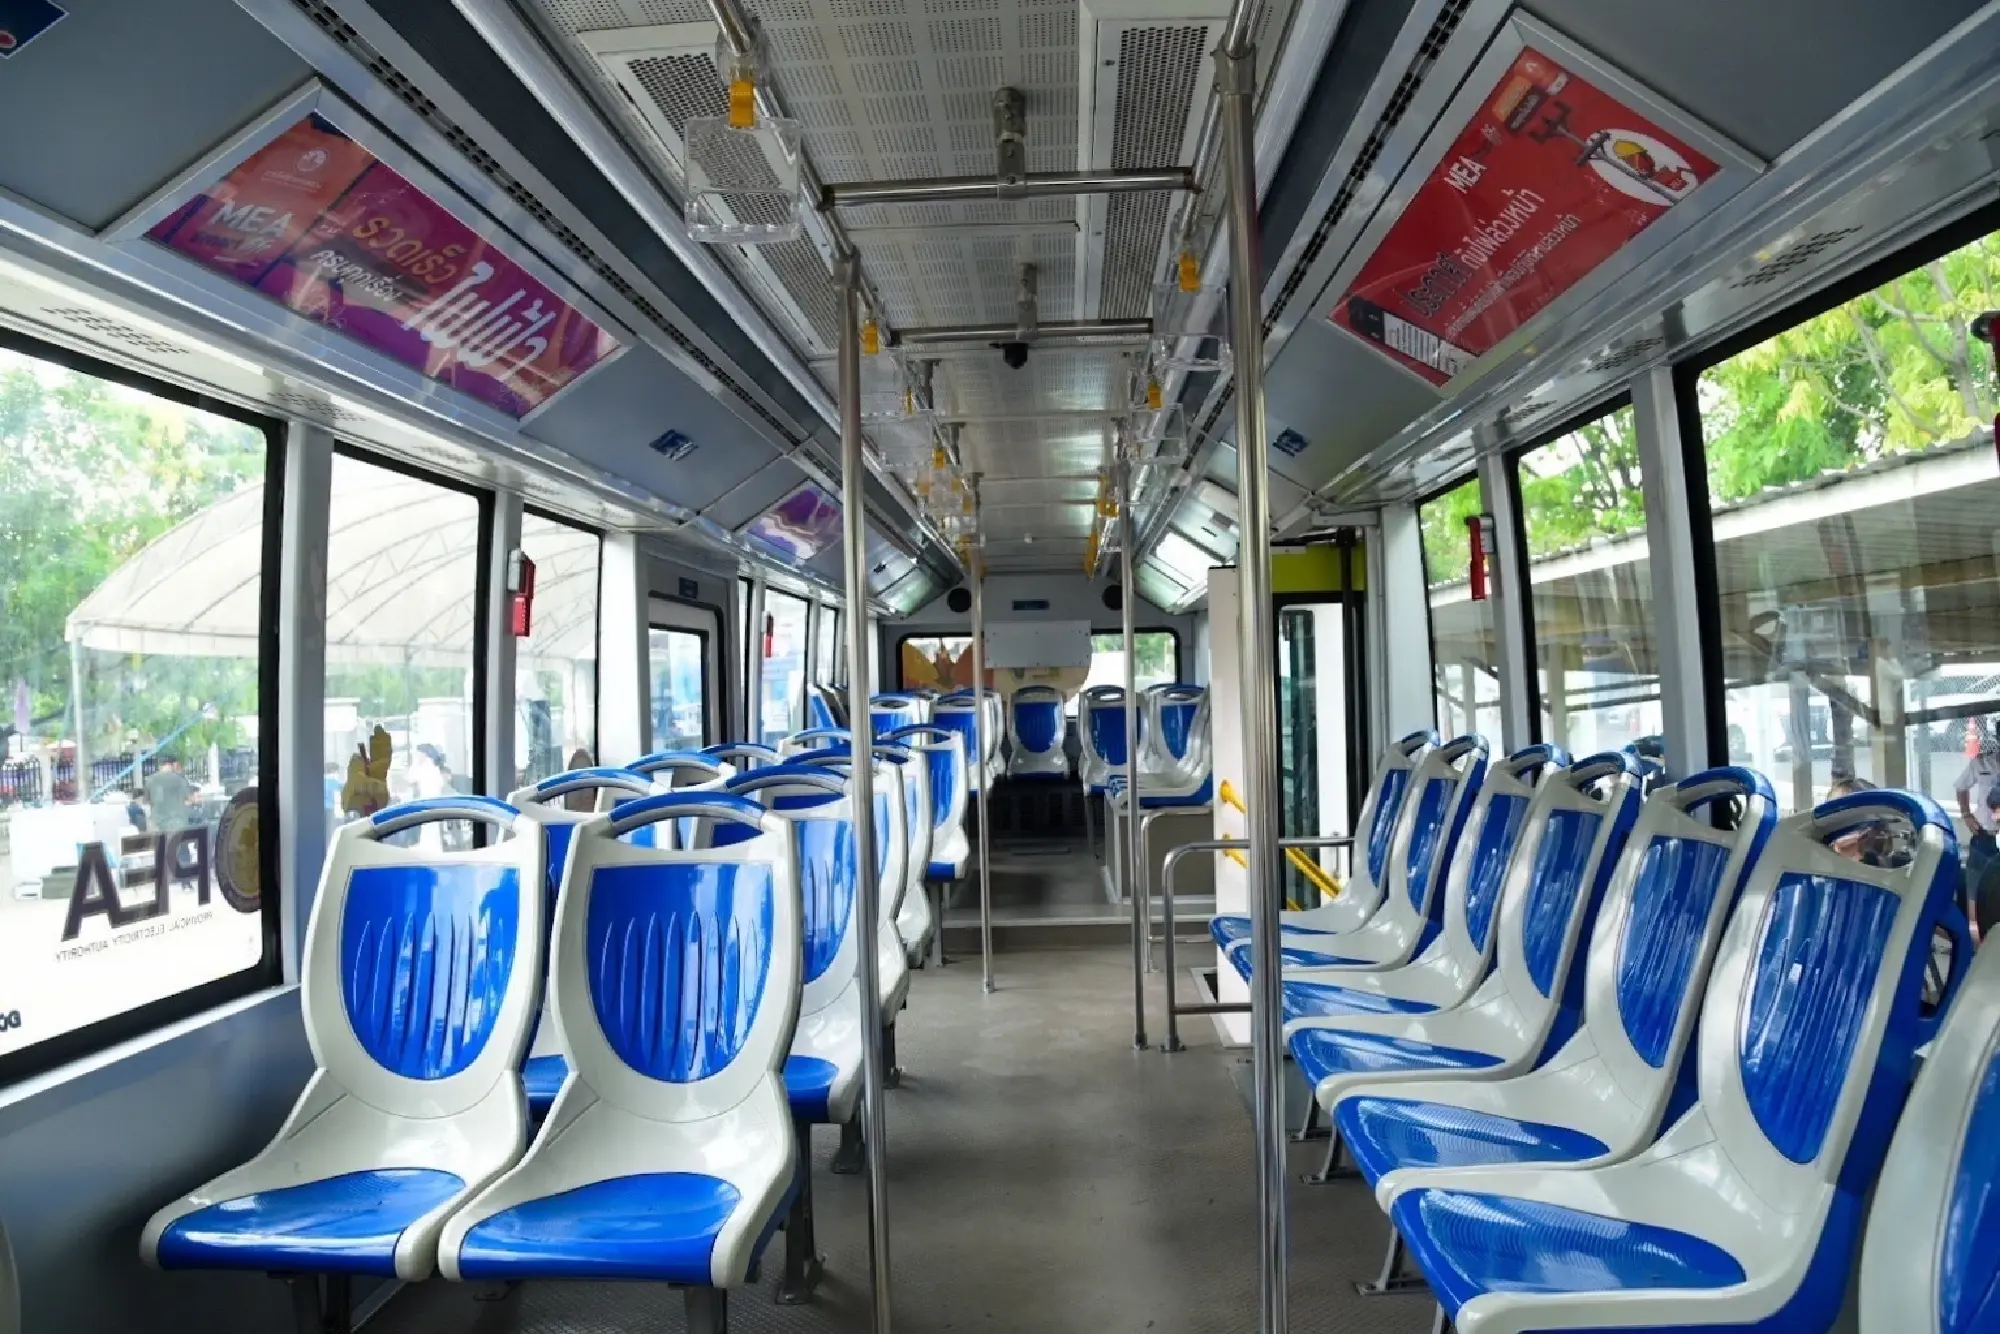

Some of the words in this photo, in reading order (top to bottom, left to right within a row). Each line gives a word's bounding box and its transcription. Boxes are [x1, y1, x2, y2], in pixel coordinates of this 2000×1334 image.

[1444, 155, 1487, 195] MEA
[208, 198, 295, 239] MEA
[352, 216, 467, 284] รวดเร็ว
